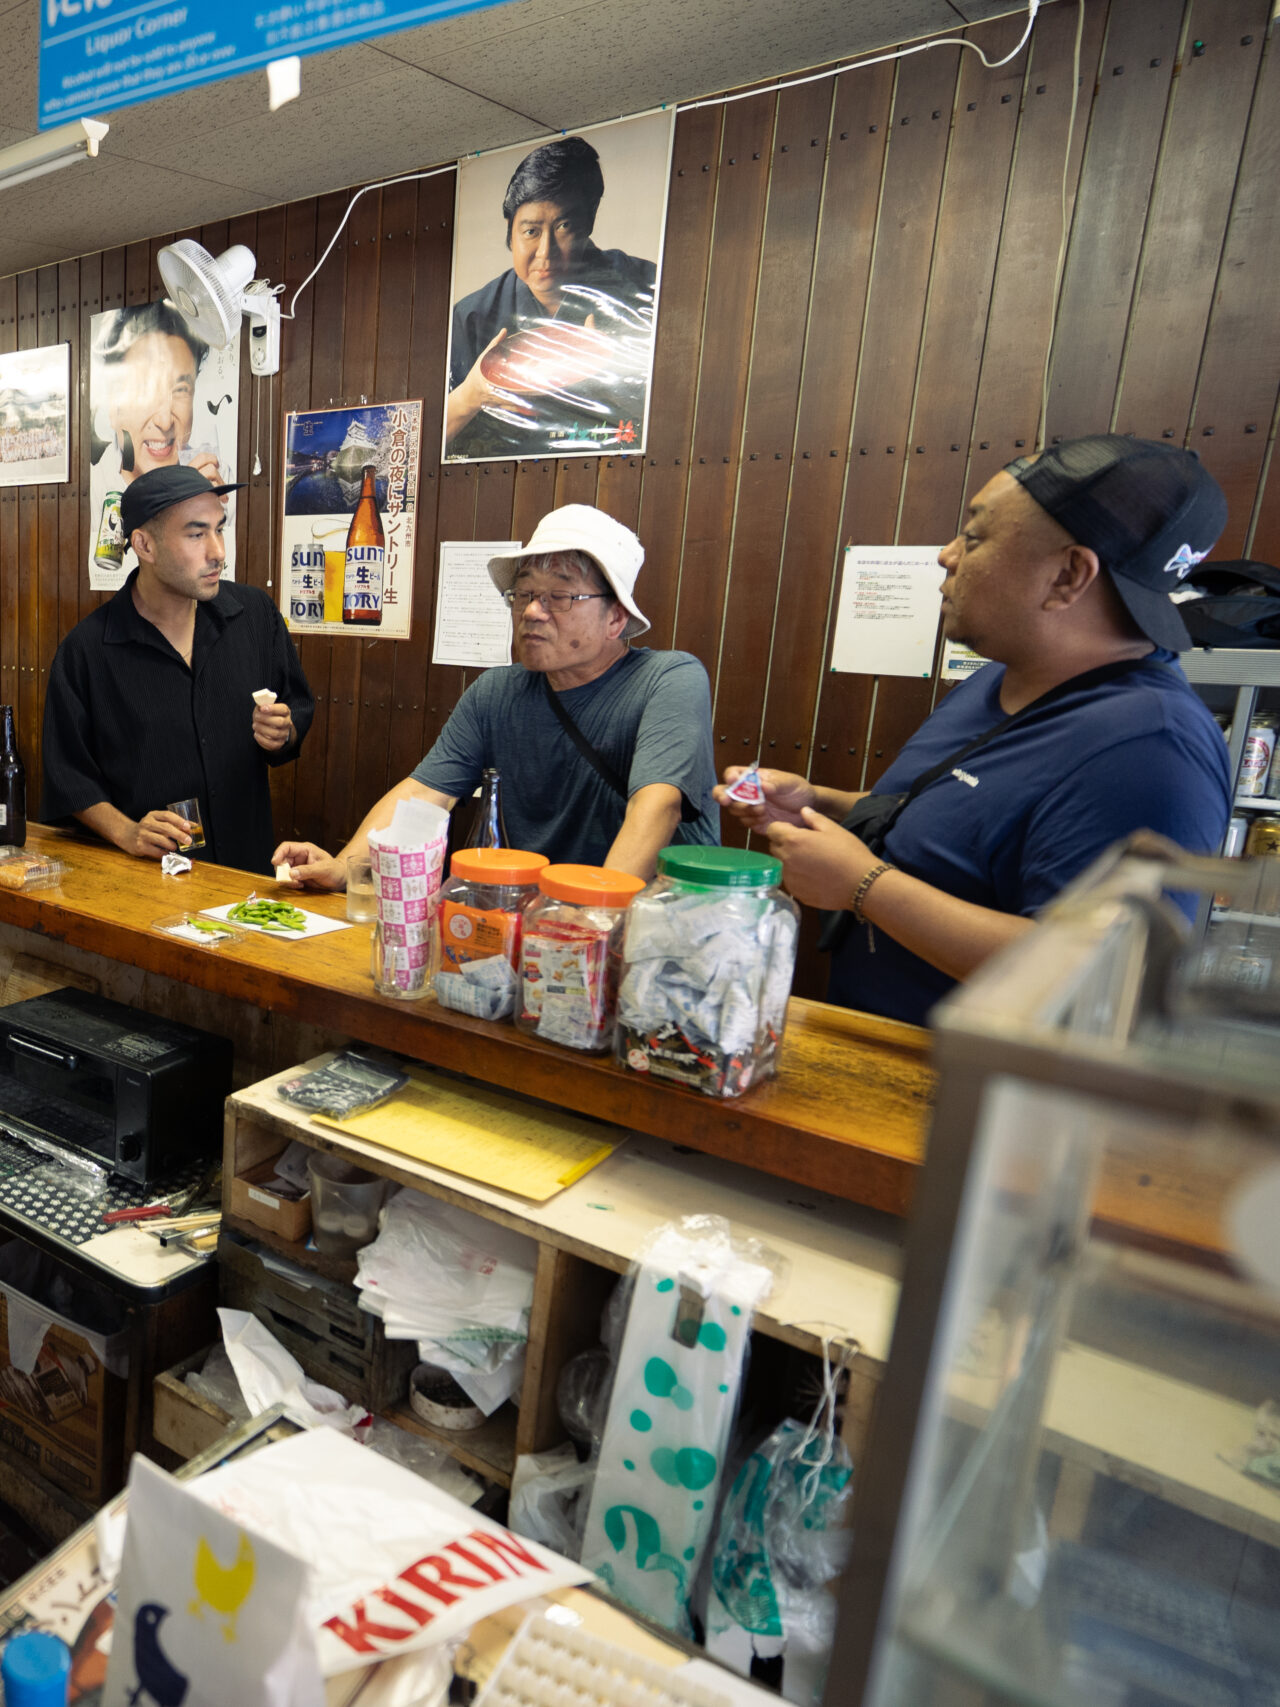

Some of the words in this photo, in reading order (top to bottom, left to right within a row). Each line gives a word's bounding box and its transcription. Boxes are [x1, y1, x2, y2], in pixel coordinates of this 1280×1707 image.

[383, 409, 408, 605] 小倉の夜にサントリー生
[321, 1529, 553, 1654] KIRIN
